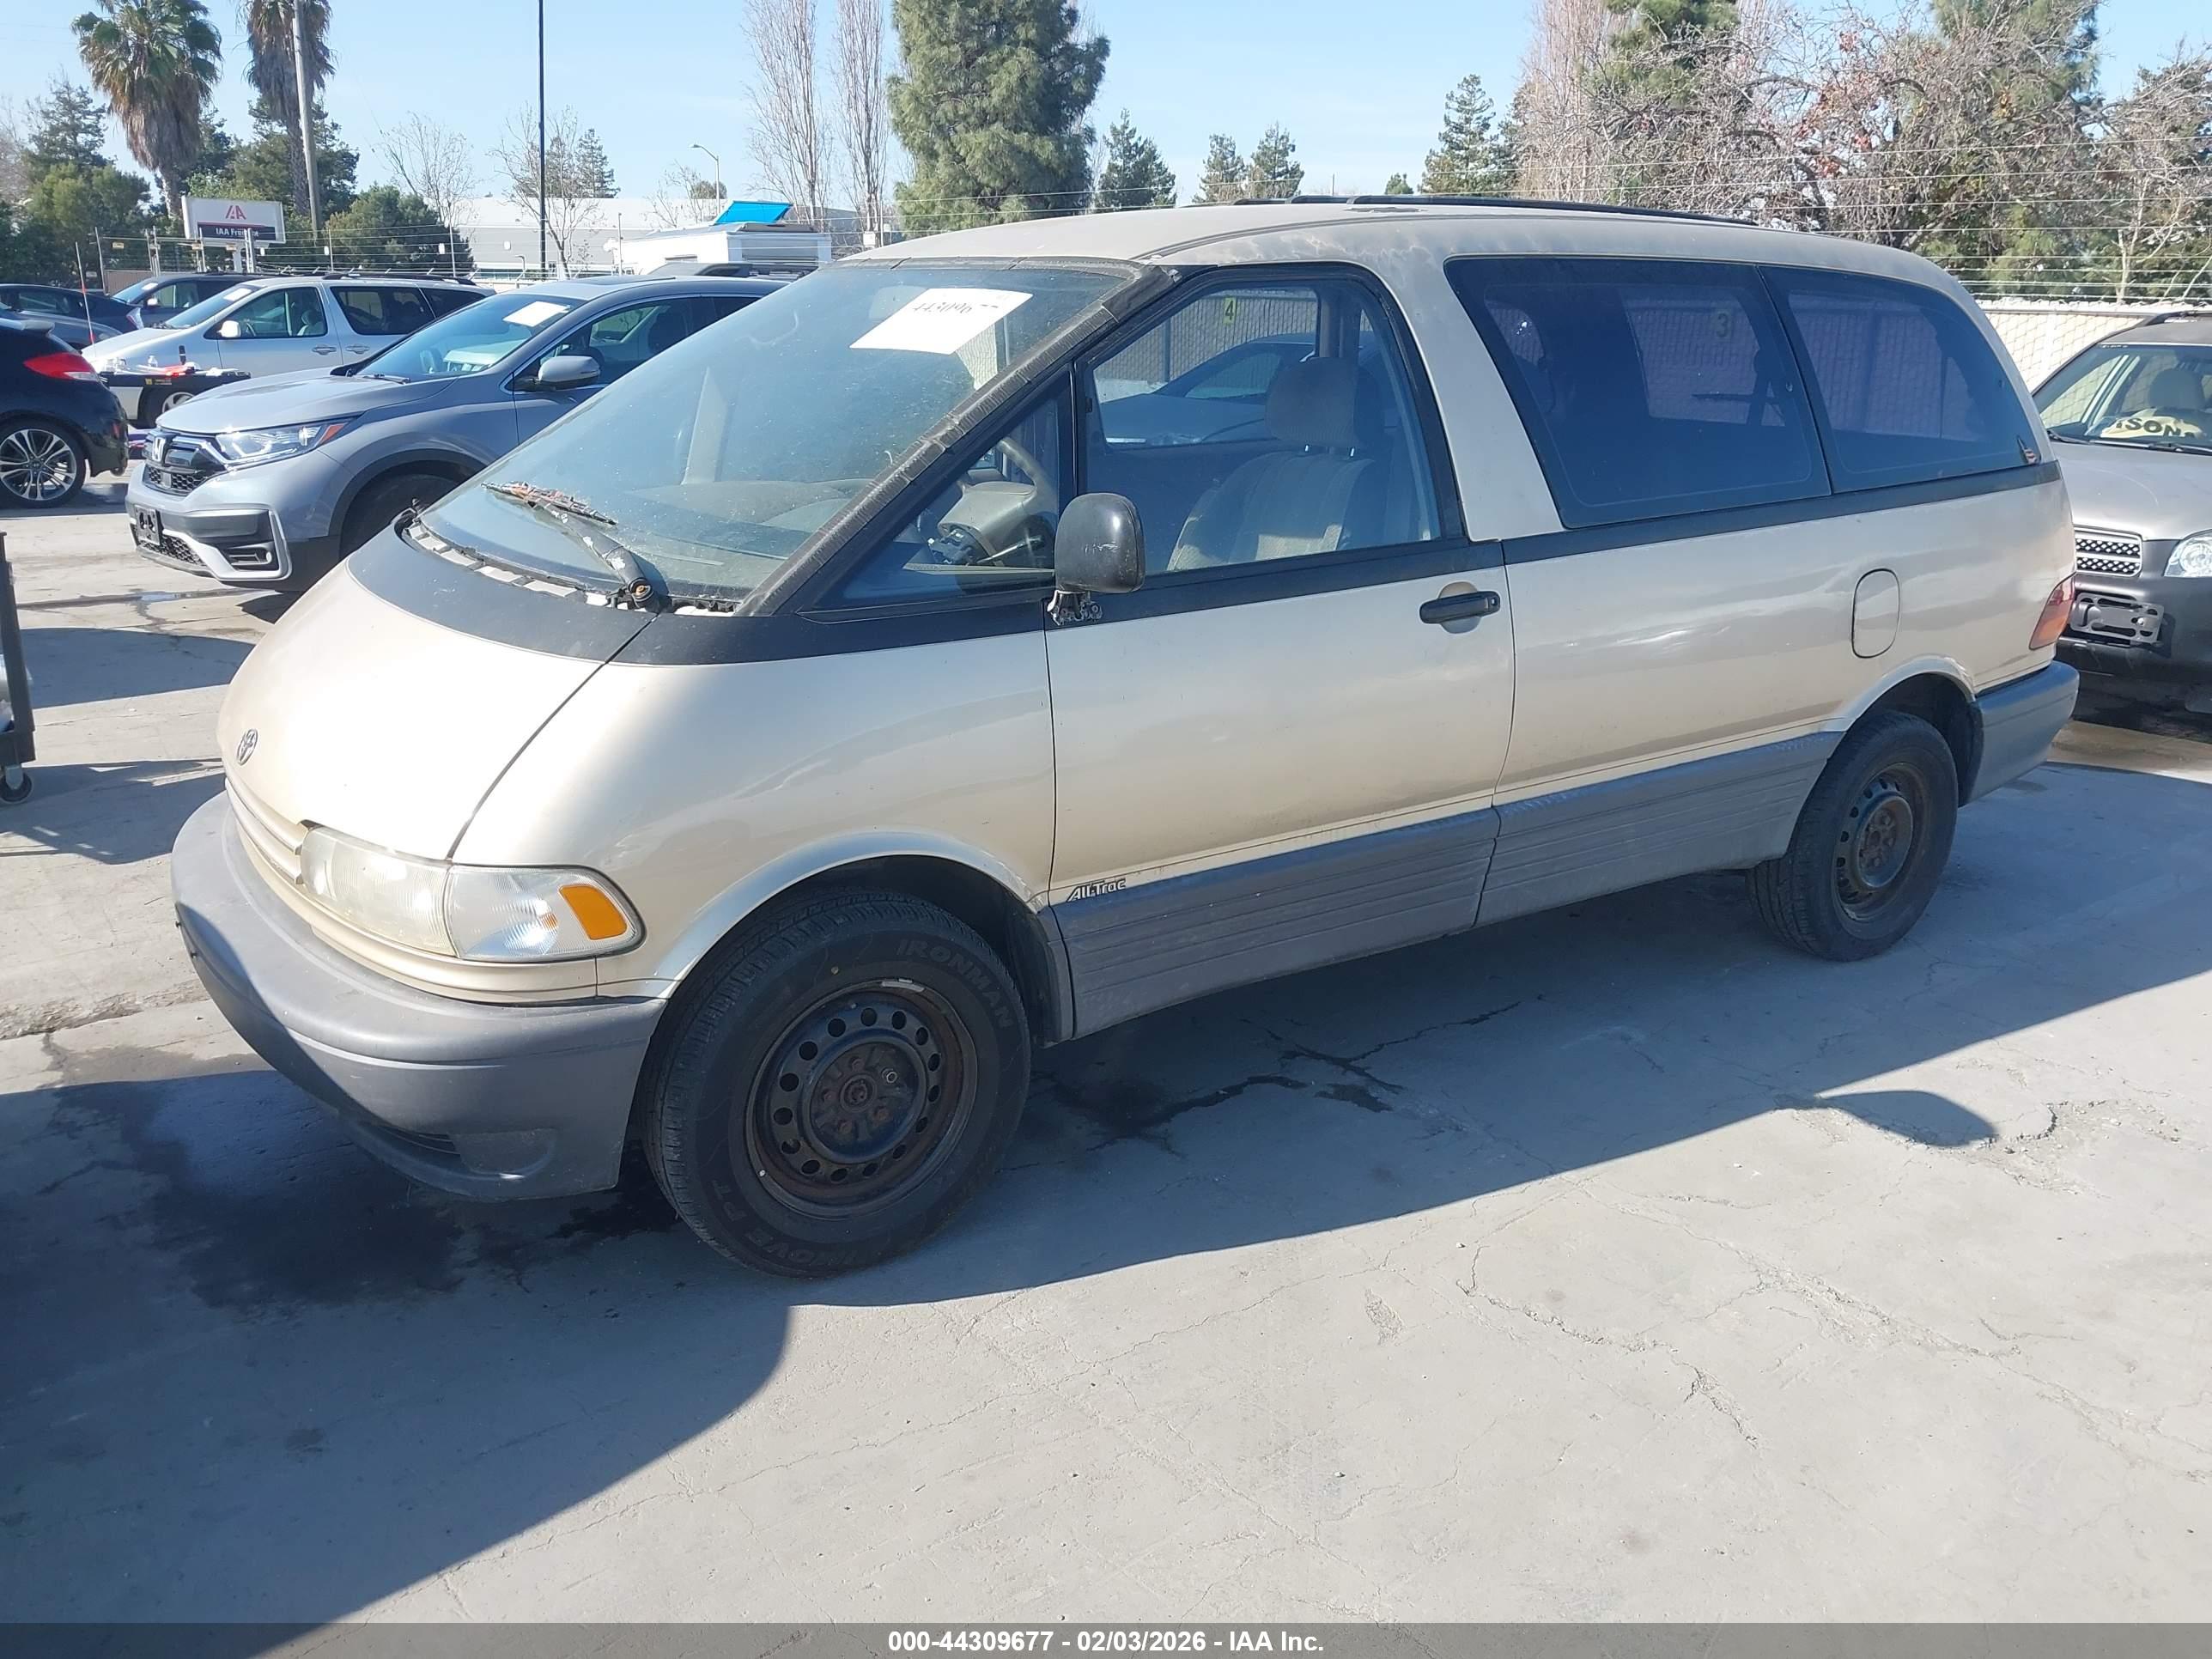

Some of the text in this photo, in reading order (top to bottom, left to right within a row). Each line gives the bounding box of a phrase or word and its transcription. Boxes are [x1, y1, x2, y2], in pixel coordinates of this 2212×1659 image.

[1224, 301, 1234, 320] 4
[1717, 313, 1729, 337] 3
[895, 939, 1015, 1030] IRONMAN
